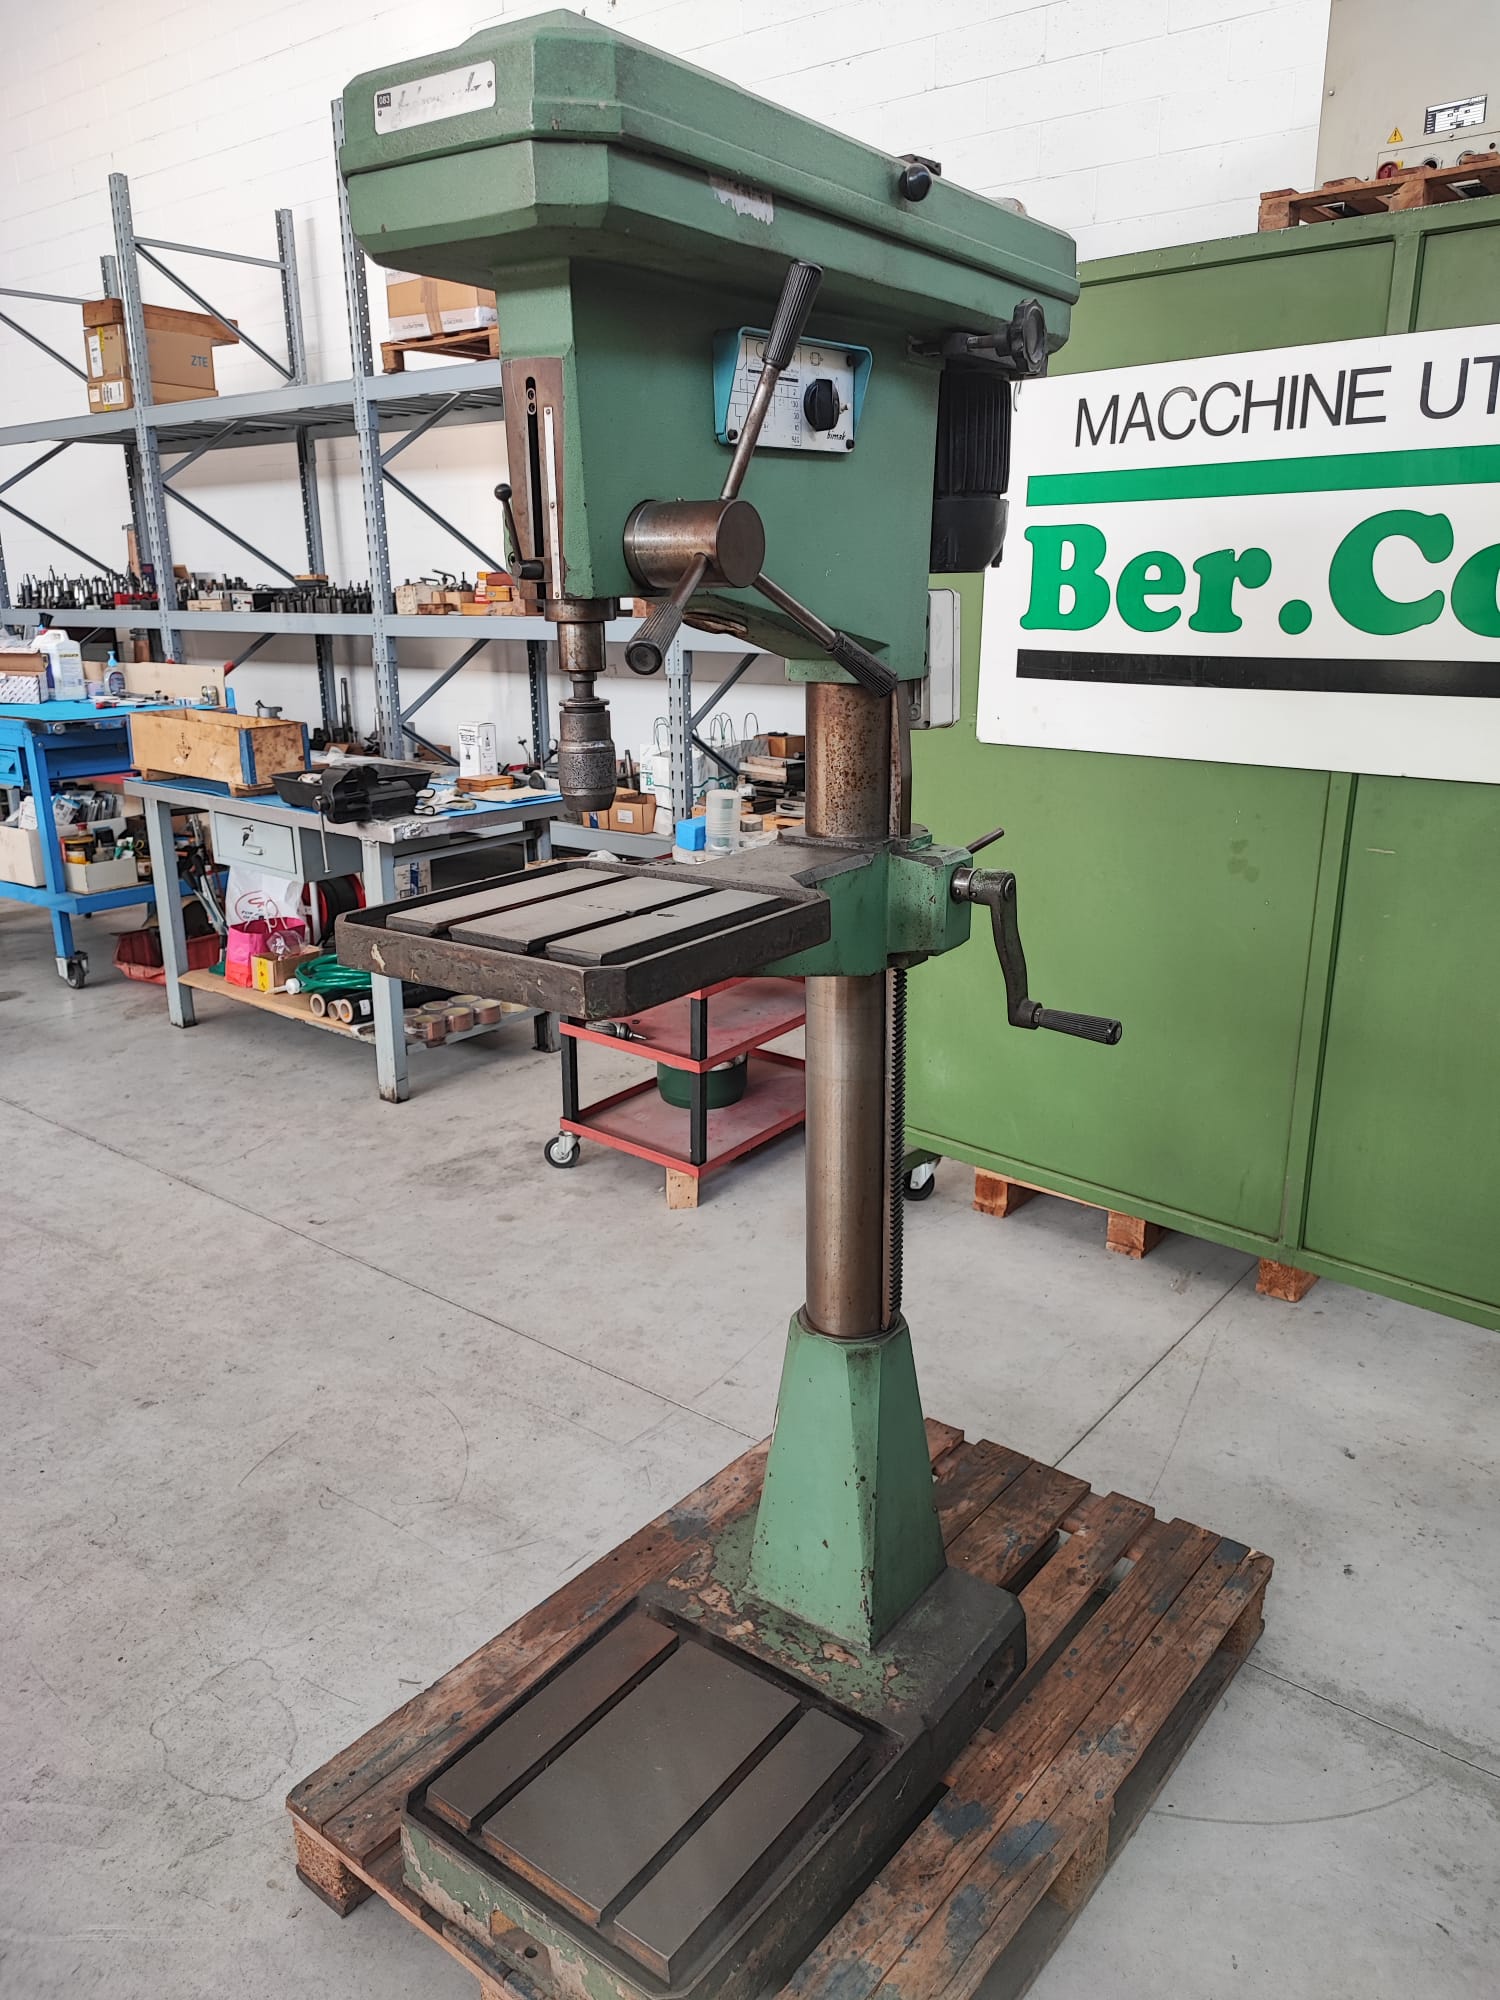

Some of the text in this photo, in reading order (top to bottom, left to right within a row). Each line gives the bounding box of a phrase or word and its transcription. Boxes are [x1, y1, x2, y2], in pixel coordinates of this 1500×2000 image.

[191, 355, 208, 367] ZTE
[1074, 354, 1500, 448] MACCHINE UT
